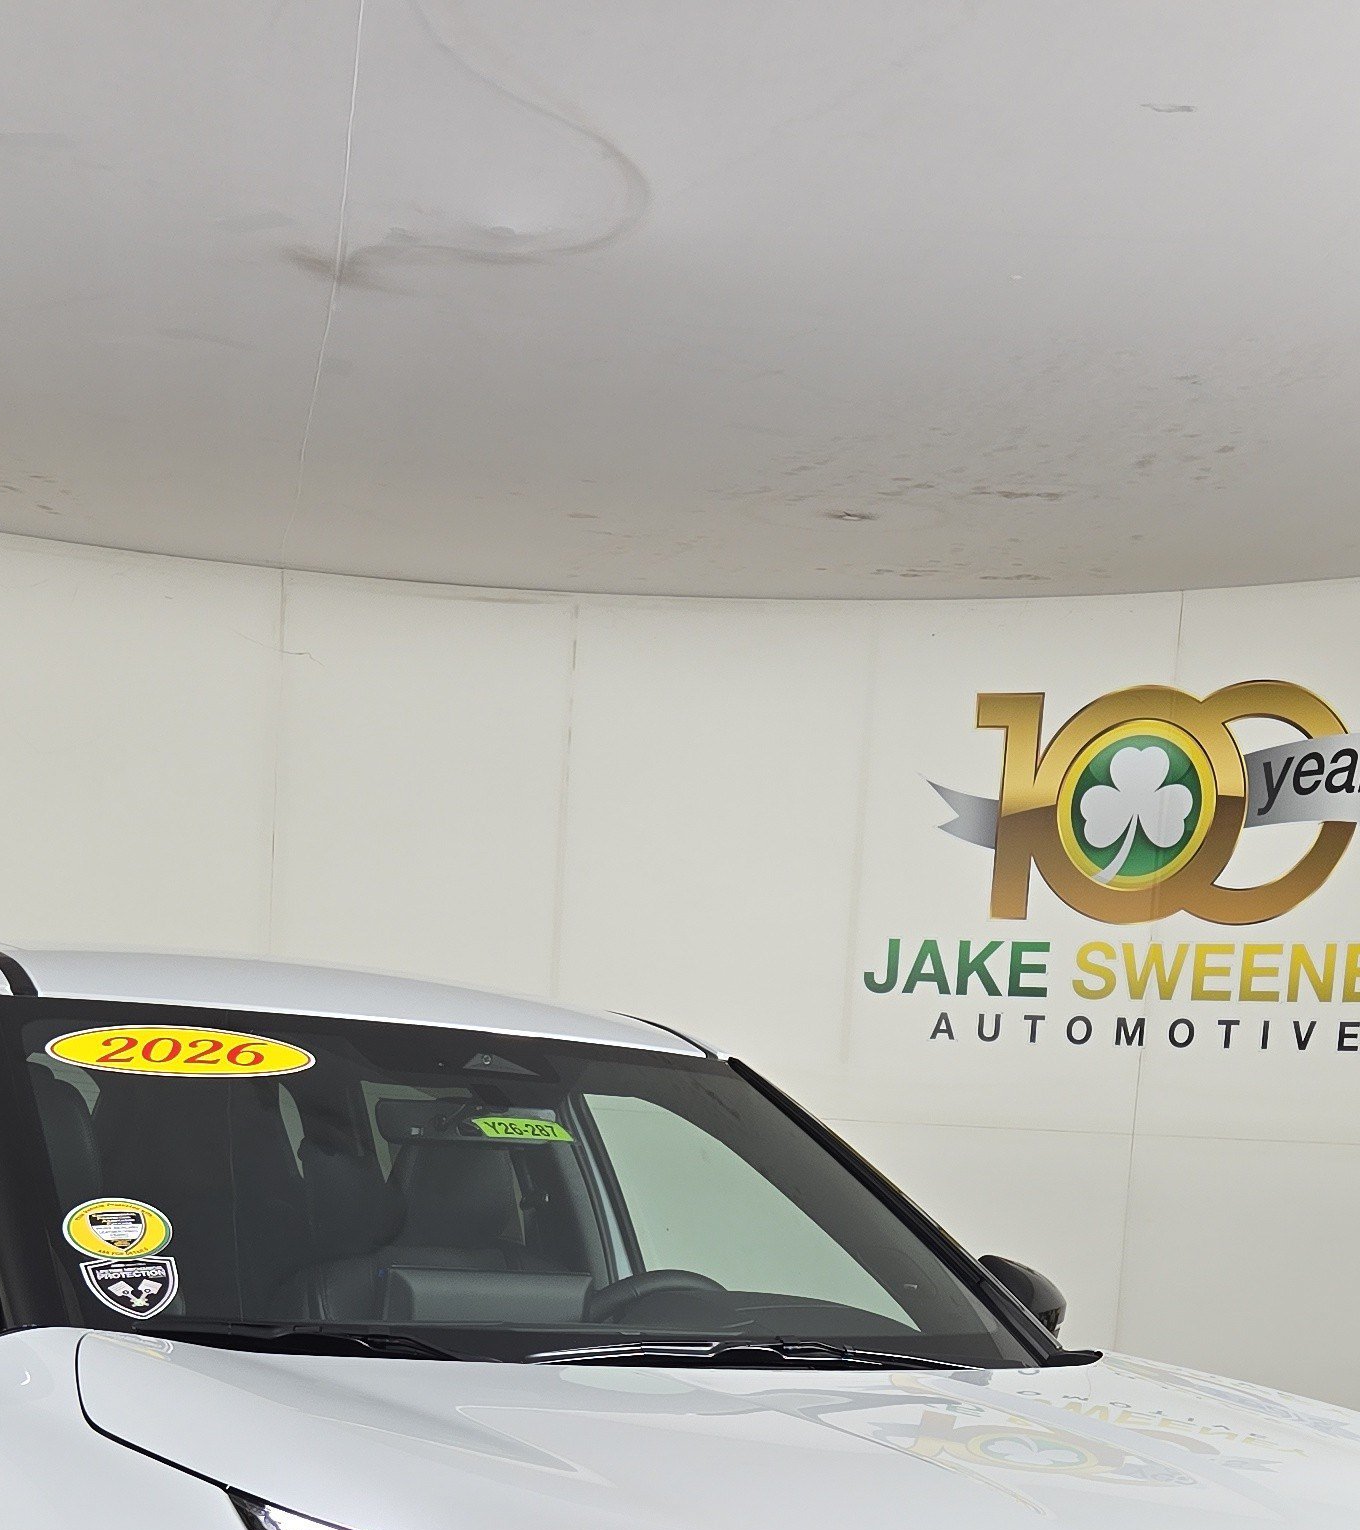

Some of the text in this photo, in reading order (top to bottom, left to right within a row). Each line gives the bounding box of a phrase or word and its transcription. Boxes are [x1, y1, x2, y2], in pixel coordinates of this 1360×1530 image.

[976, 679, 1358, 926] 100
[863, 938, 1051, 998] JAKE
[95, 1036, 268, 1067] 2026
[483, 1121, 559, 1138] Y26-287
[96, 1268, 166, 1280] PROTECTION
